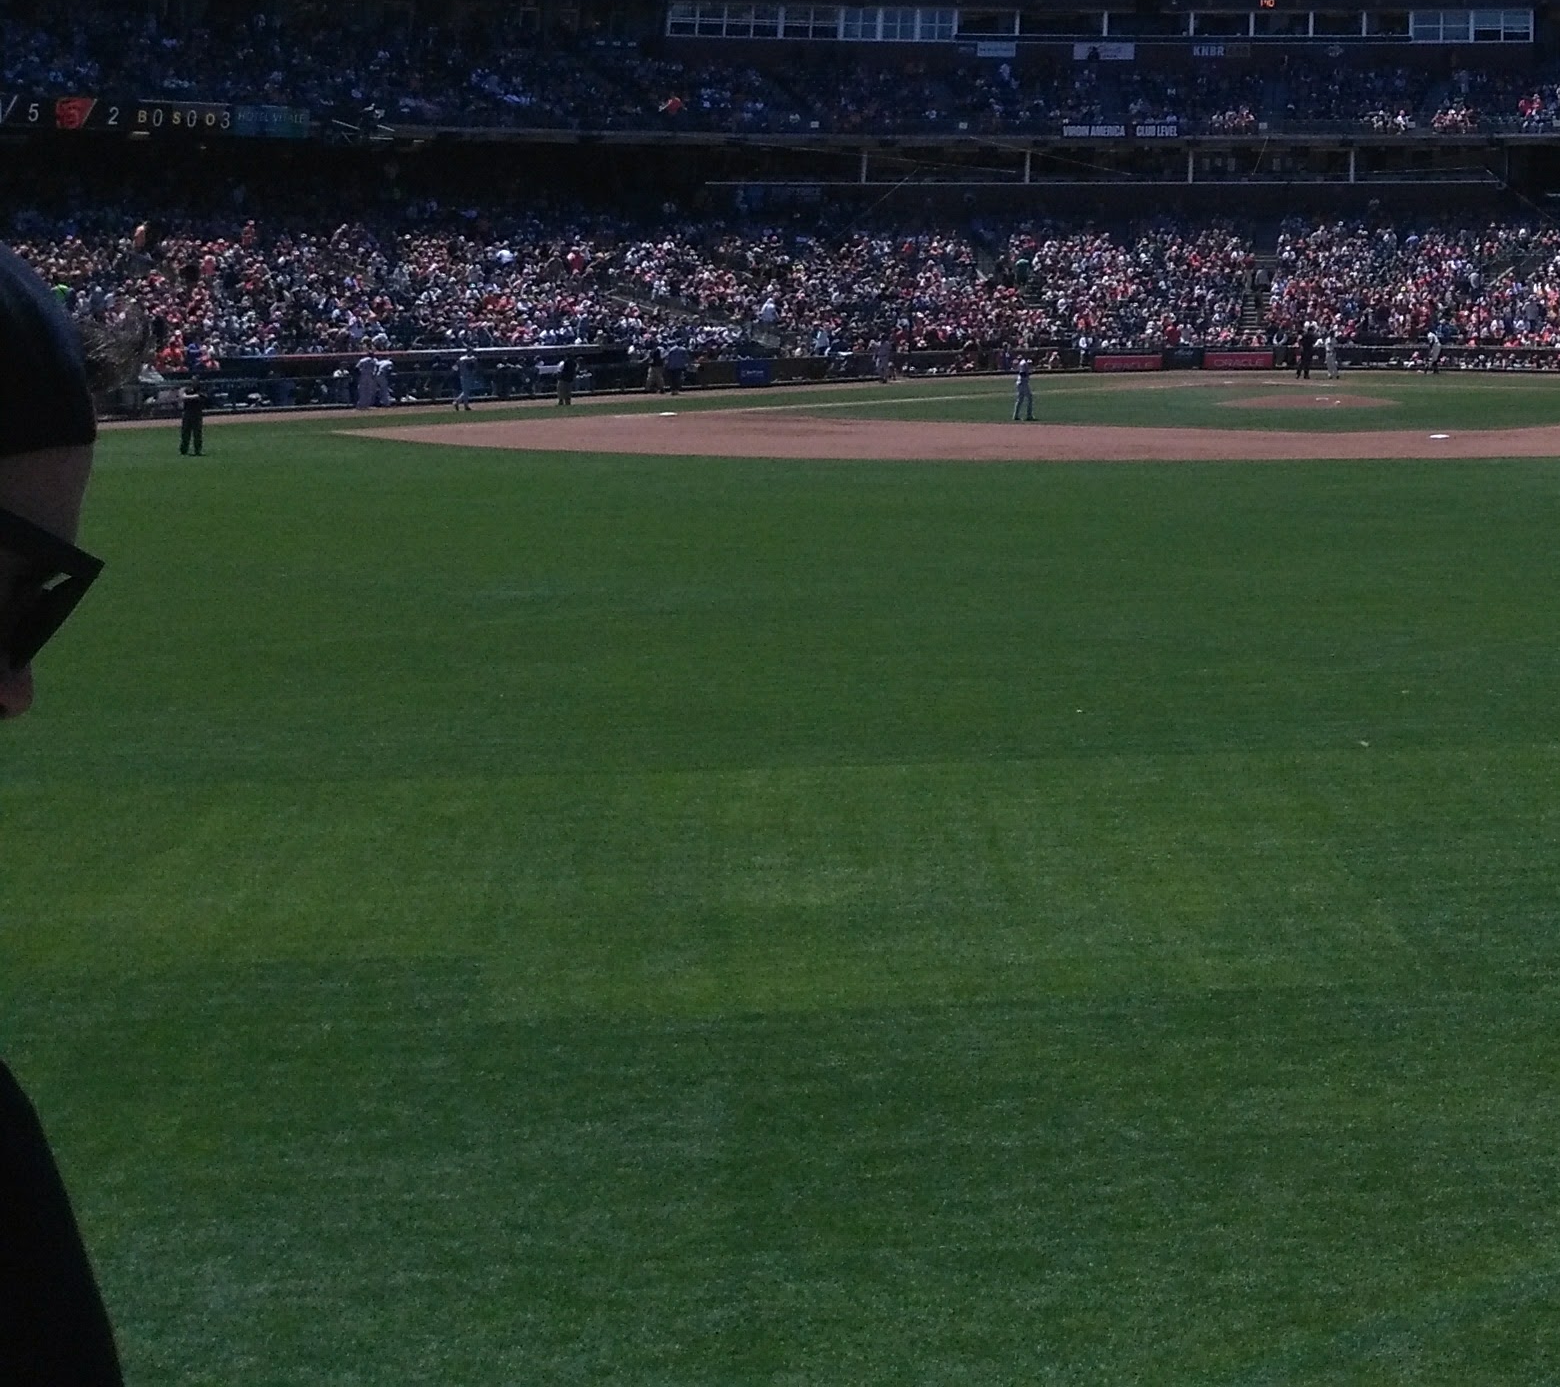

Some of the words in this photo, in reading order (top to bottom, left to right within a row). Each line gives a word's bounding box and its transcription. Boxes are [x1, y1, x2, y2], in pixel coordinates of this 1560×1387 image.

[1193, 45, 1225, 56] KNBR
[28, 103, 39, 122] 5
[107, 106, 119, 125] 2
[137, 109, 148, 123] B
[152, 108, 163, 127] 0
[172, 111, 182, 125] S
[186, 109, 197, 128] 0
[220, 111, 231, 129] 3
[1136, 125, 1156, 137] CLUB
[1156, 125, 1178, 137] LEVEL
